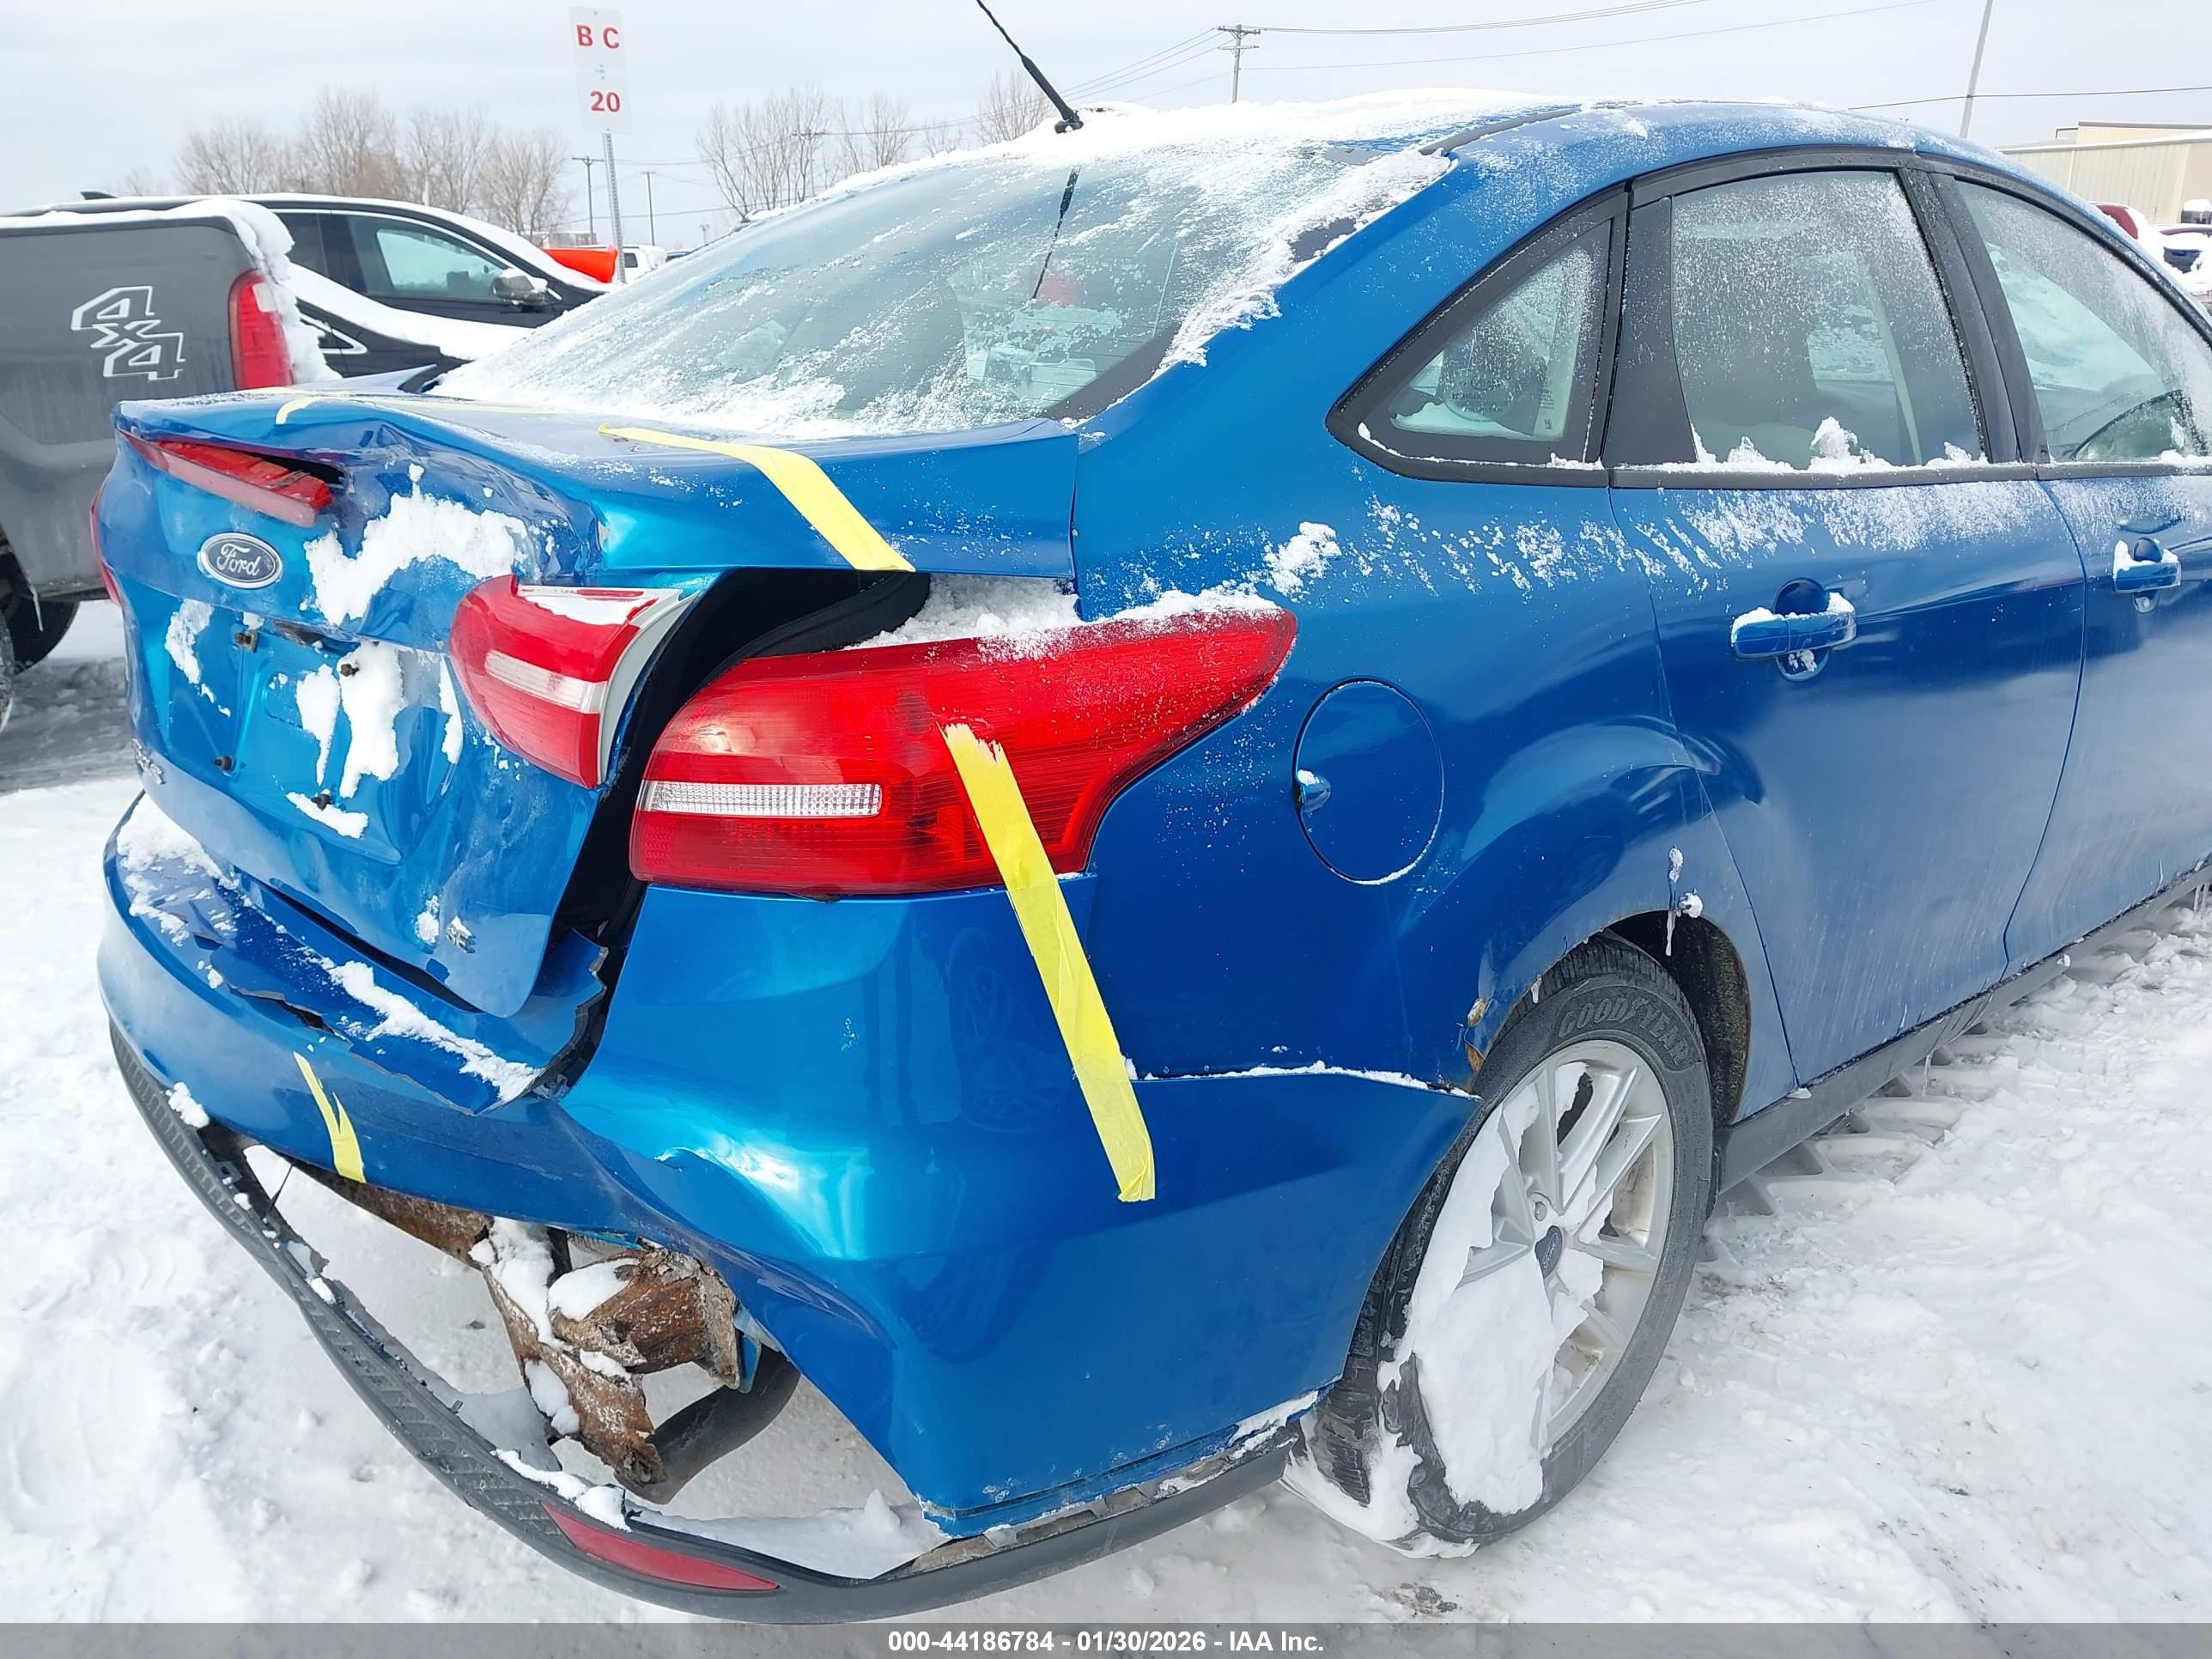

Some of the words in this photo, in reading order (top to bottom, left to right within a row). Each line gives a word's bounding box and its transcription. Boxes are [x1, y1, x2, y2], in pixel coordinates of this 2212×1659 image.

[576, 24, 593, 46] B
[603, 27, 620, 49] C
[590, 90, 621, 112] 20
[216, 543, 261, 576] Ford
